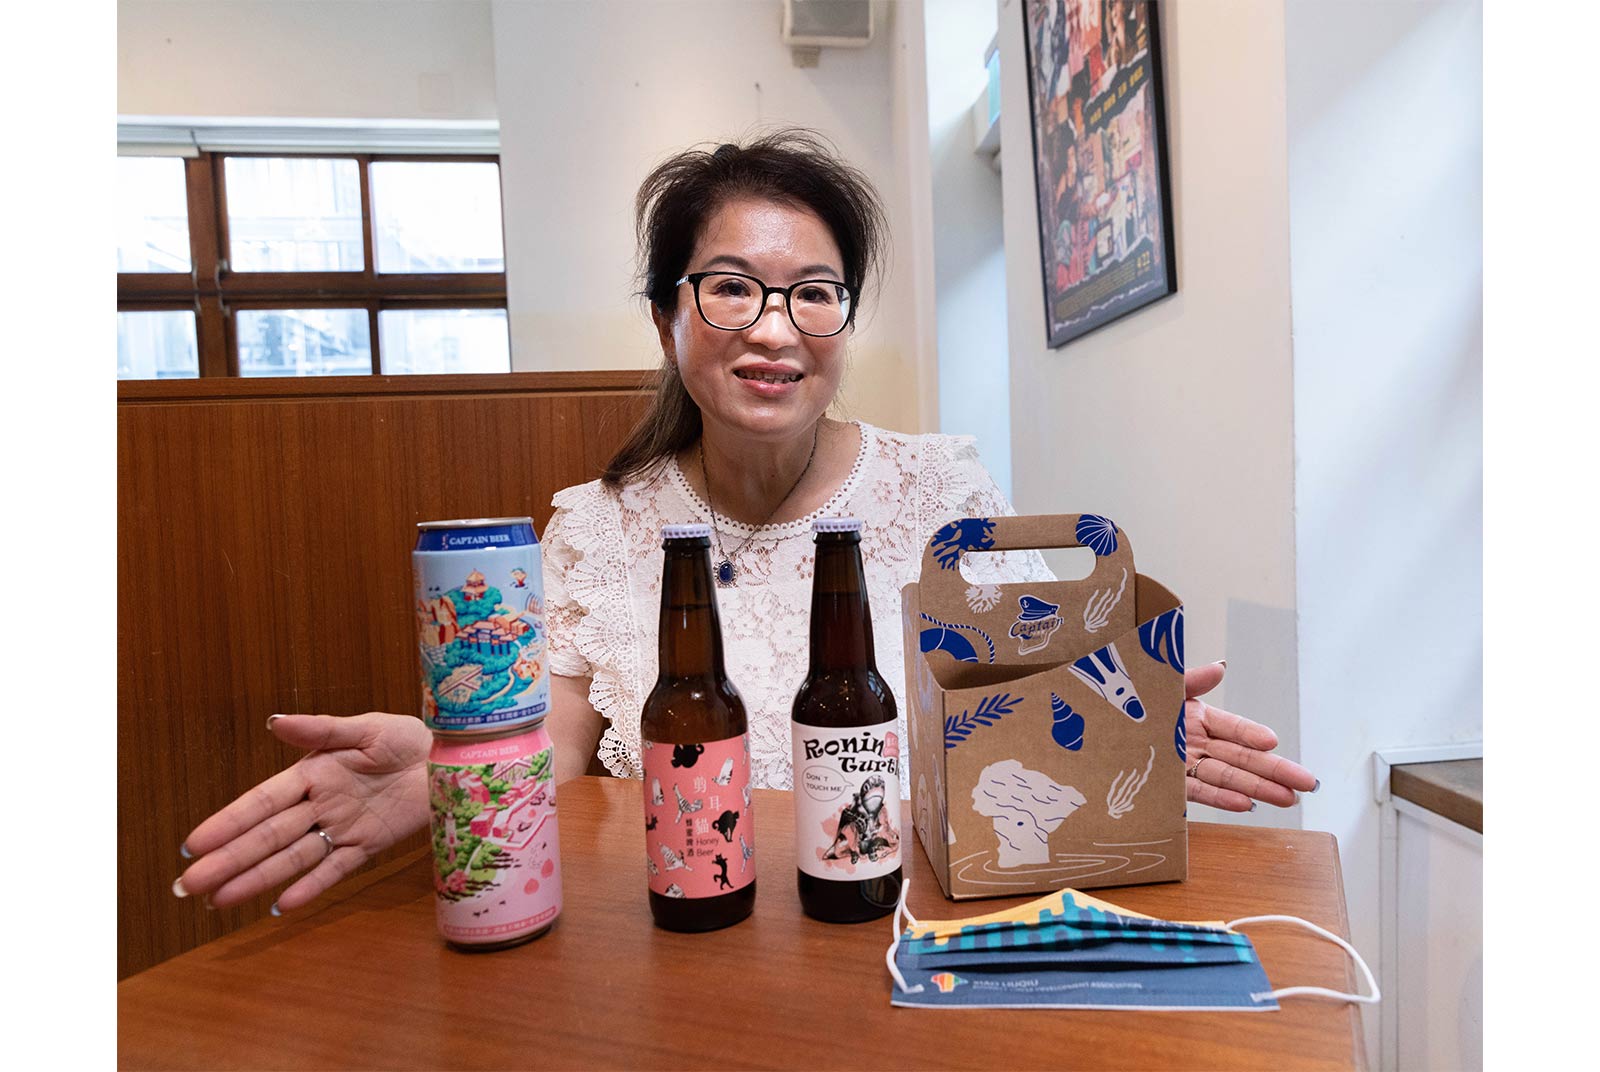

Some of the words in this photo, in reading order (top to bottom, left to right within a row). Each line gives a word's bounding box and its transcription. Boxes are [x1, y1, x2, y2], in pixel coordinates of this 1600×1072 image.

[449, 535, 488, 545] CAPTAIN
[489, 534, 511, 543] BEER
[803, 732, 884, 760] Ronin
[460, 749, 497, 759] CAPTAIN
[499, 745, 519, 756] BEER
[806, 782, 828, 791] TOUCH
[696, 836, 719, 847] Honey
[696, 847, 714, 857] Beer
